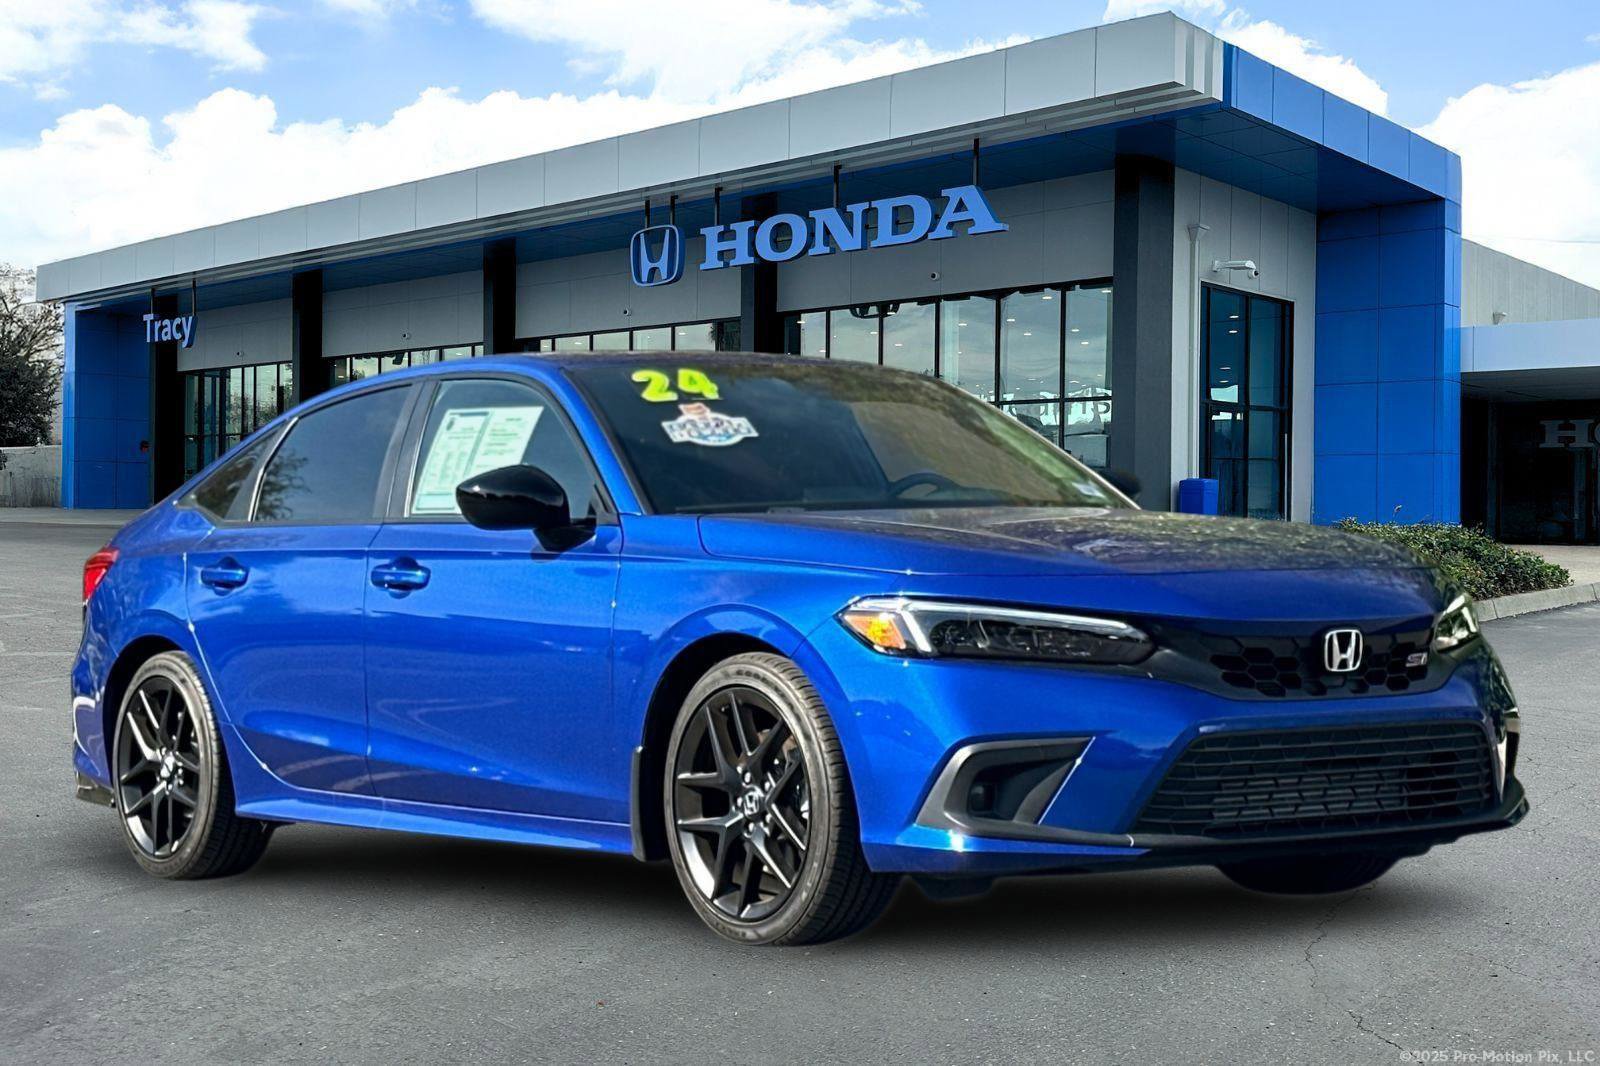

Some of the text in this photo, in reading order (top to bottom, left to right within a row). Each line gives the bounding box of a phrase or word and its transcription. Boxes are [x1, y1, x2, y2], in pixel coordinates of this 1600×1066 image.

[699, 184, 1010, 271] HONDA
[142, 313, 194, 349] Tracy
[631, 368, 721, 402] 24
